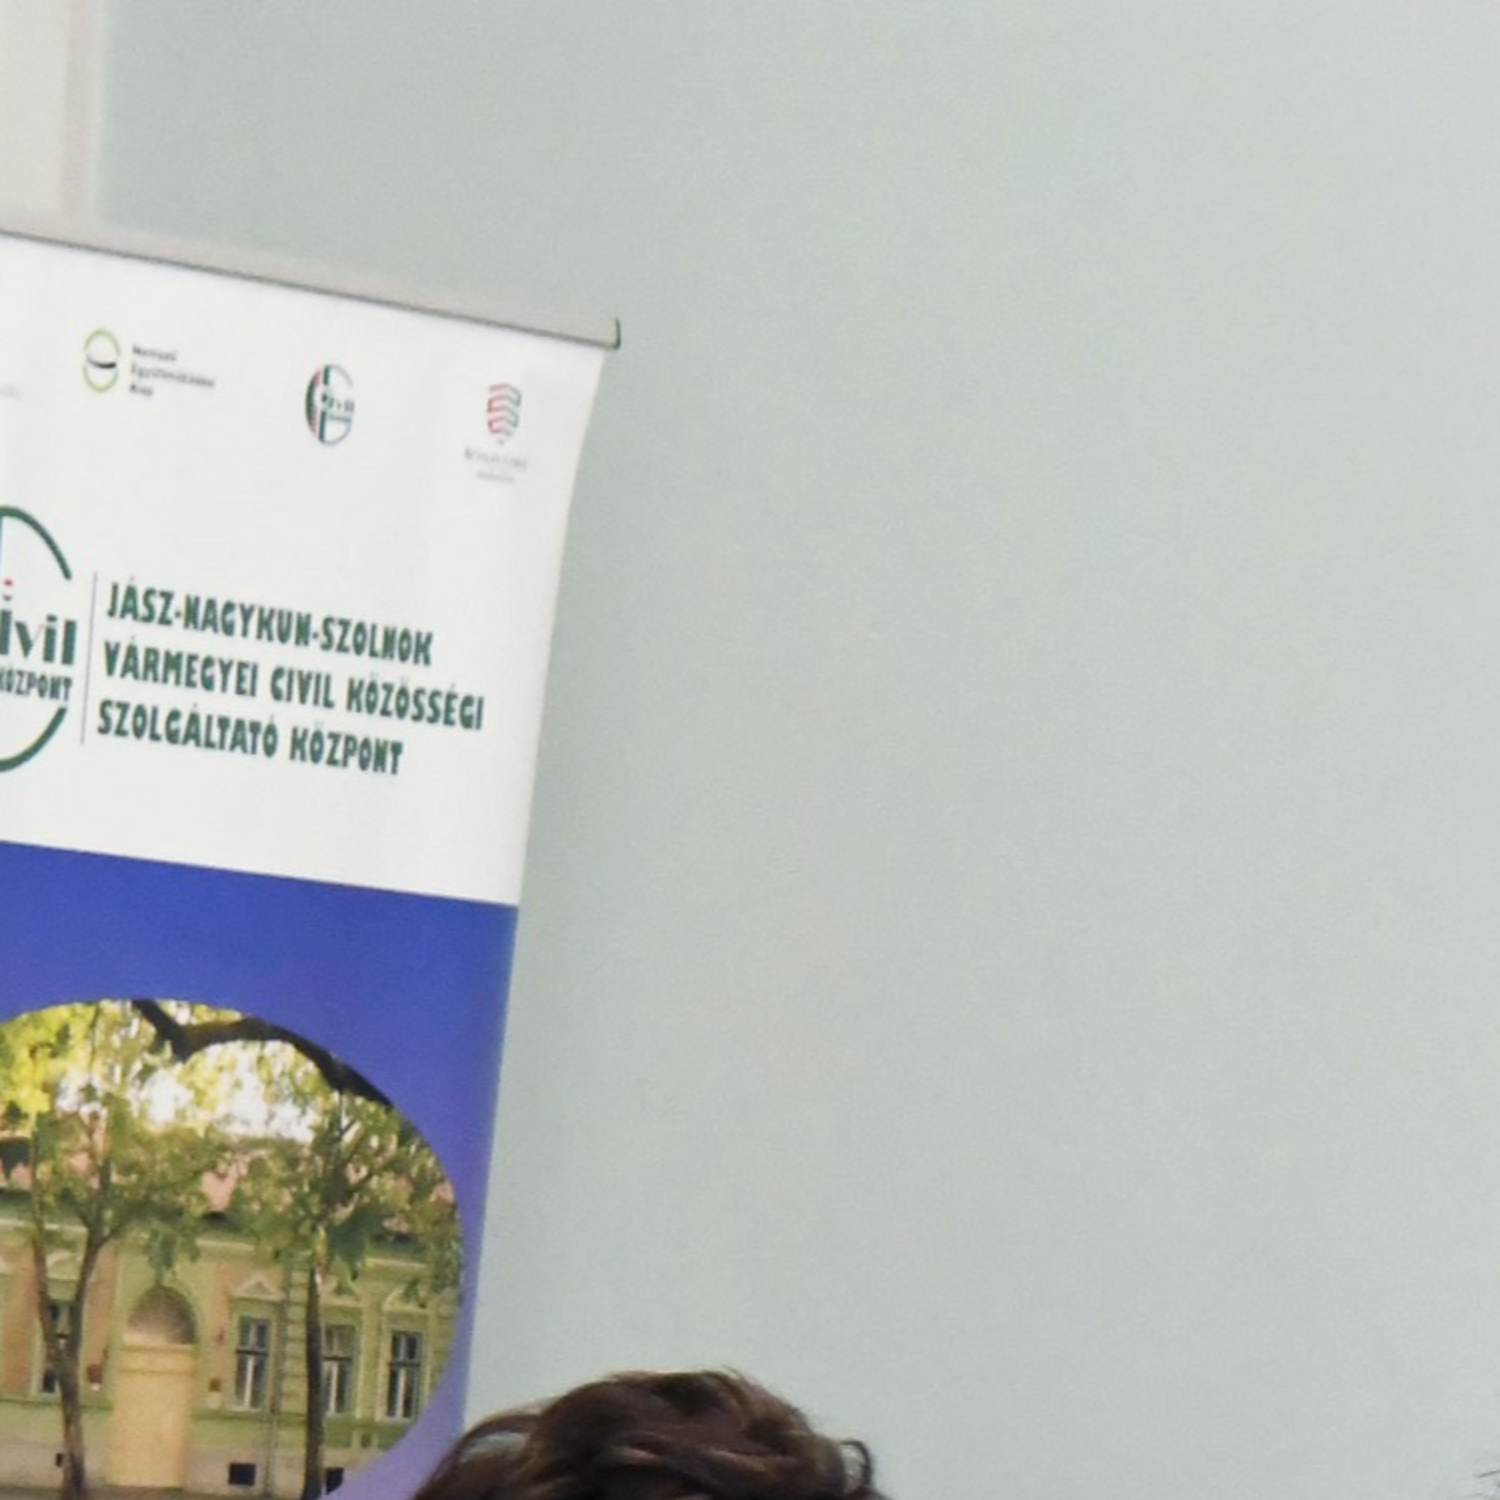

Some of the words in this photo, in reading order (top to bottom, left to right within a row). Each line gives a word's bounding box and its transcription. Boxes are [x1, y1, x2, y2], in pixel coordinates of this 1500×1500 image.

[107, 576, 433, 666] JÁSZ-NAGYKUN-SZOLNOK
[104, 635, 258, 697] VÁRMEGYEI
[270, 665, 335, 710] CIVIL
[346, 672, 485, 730] KÖZÖSSÉGI
[97, 698, 278, 758] SZOLGÁLTATÓ
[289, 721, 404, 775] KÖZPONT
